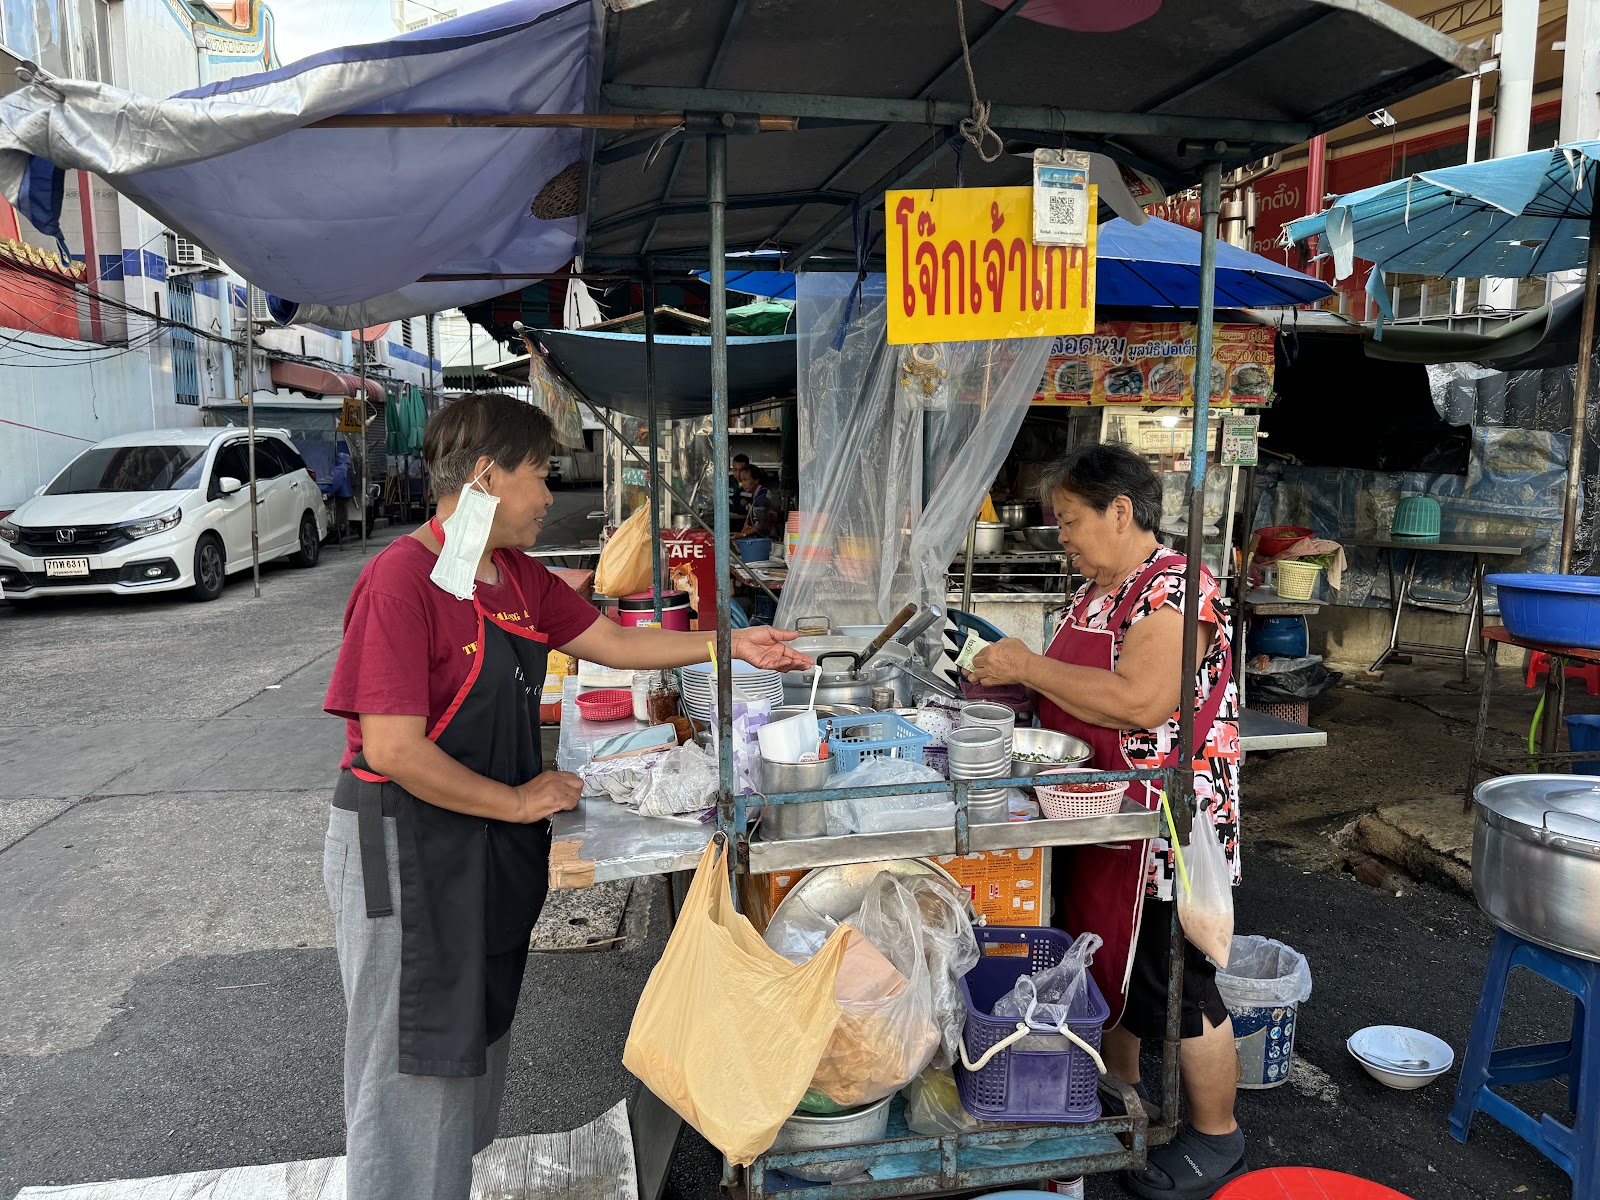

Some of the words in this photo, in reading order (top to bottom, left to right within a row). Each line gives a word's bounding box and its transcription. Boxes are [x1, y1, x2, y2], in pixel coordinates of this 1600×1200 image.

[896, 196, 1089, 318] โจ๊กเจ้าเกา
[66, 560, 86, 569] 6311
